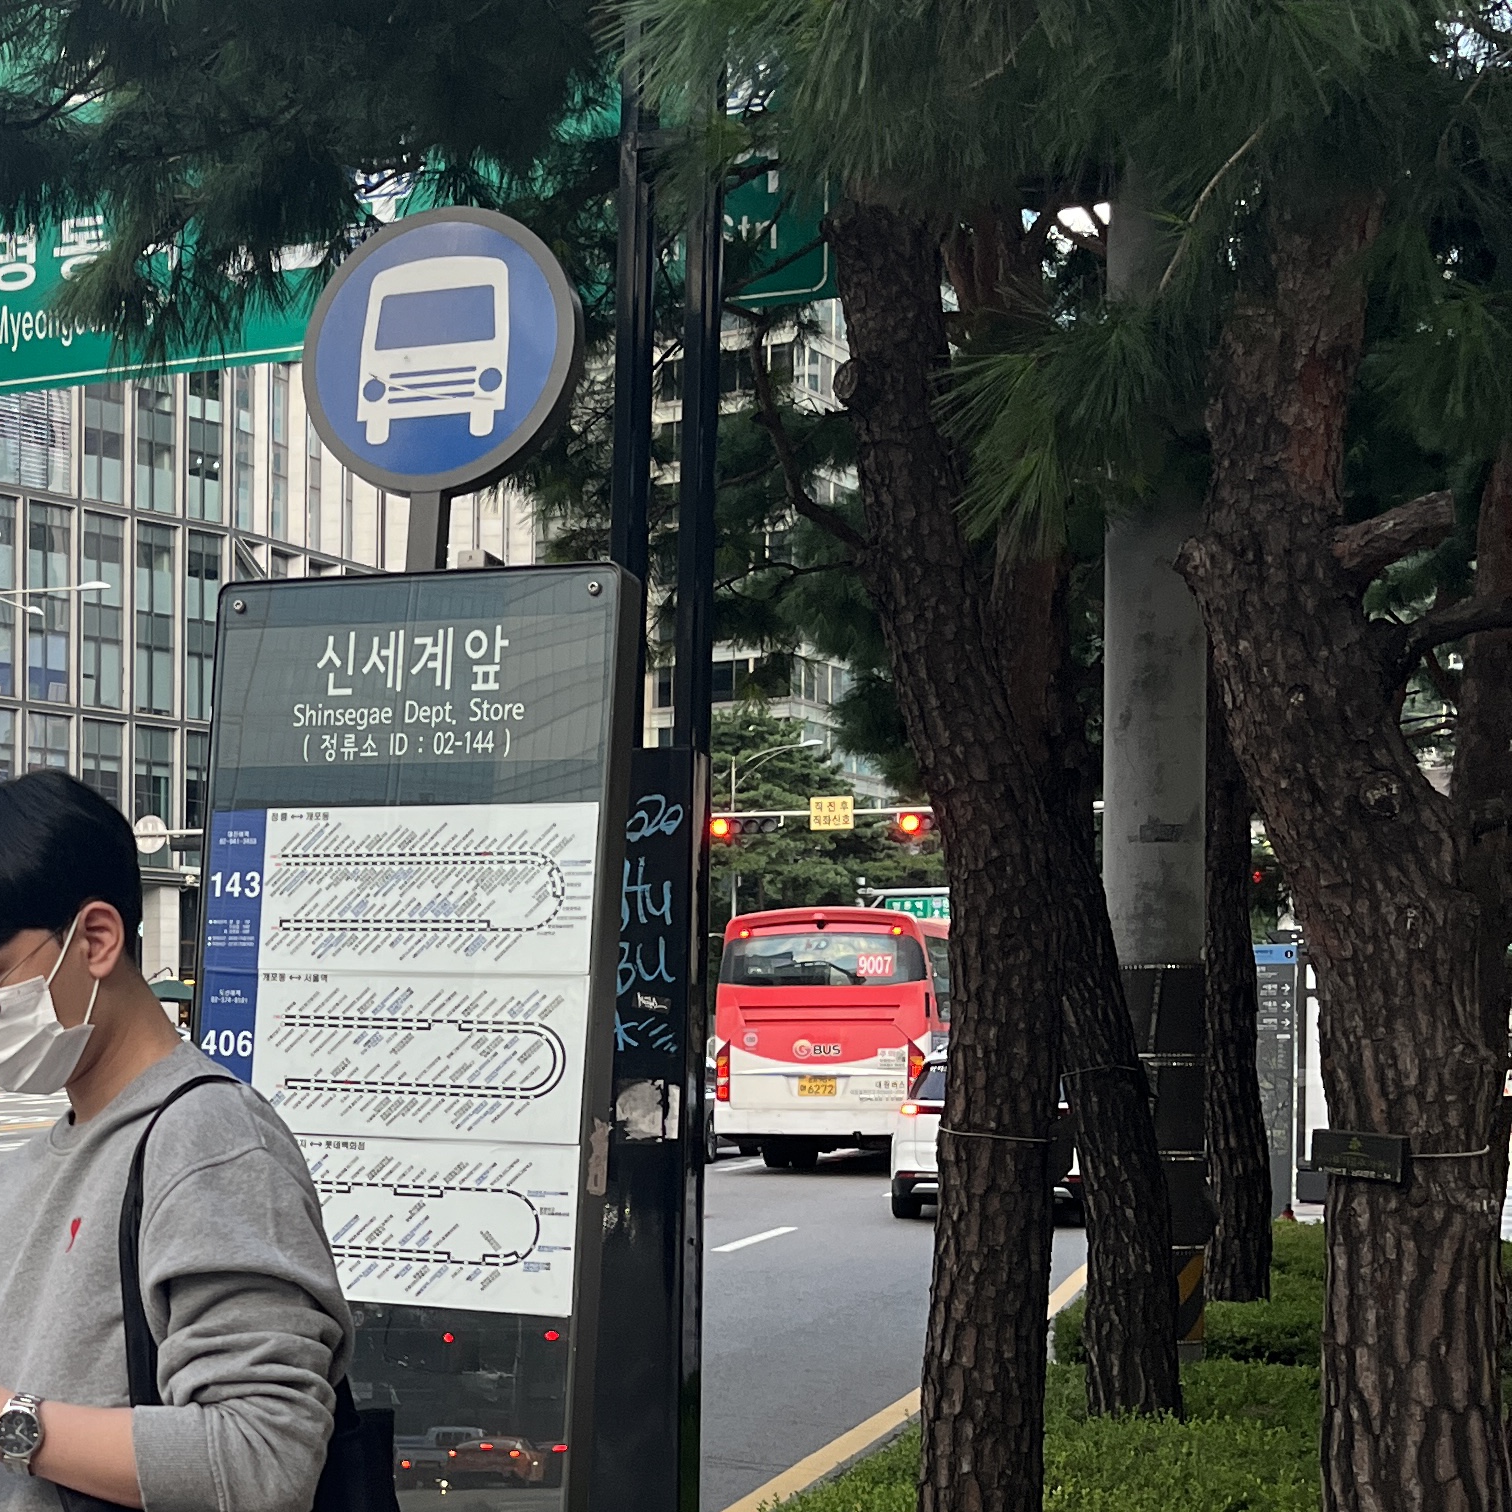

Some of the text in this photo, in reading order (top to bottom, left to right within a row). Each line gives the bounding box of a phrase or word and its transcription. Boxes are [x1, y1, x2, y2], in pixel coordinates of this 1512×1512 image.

[316, 624, 510, 696] 신세계앞
[292, 697, 525, 730] Shinsegae Dept. Store
[320, 733, 379, 762] 정류소
[389, 732, 409, 756] ID
[433, 730, 495, 756] 02-144
[210, 871, 261, 898] 143
[858, 955, 893, 975] 9007
[200, 1029, 253, 1057] 406
[813, 1045, 841, 1056] BUS
[807, 1084, 834, 1095] 6272
